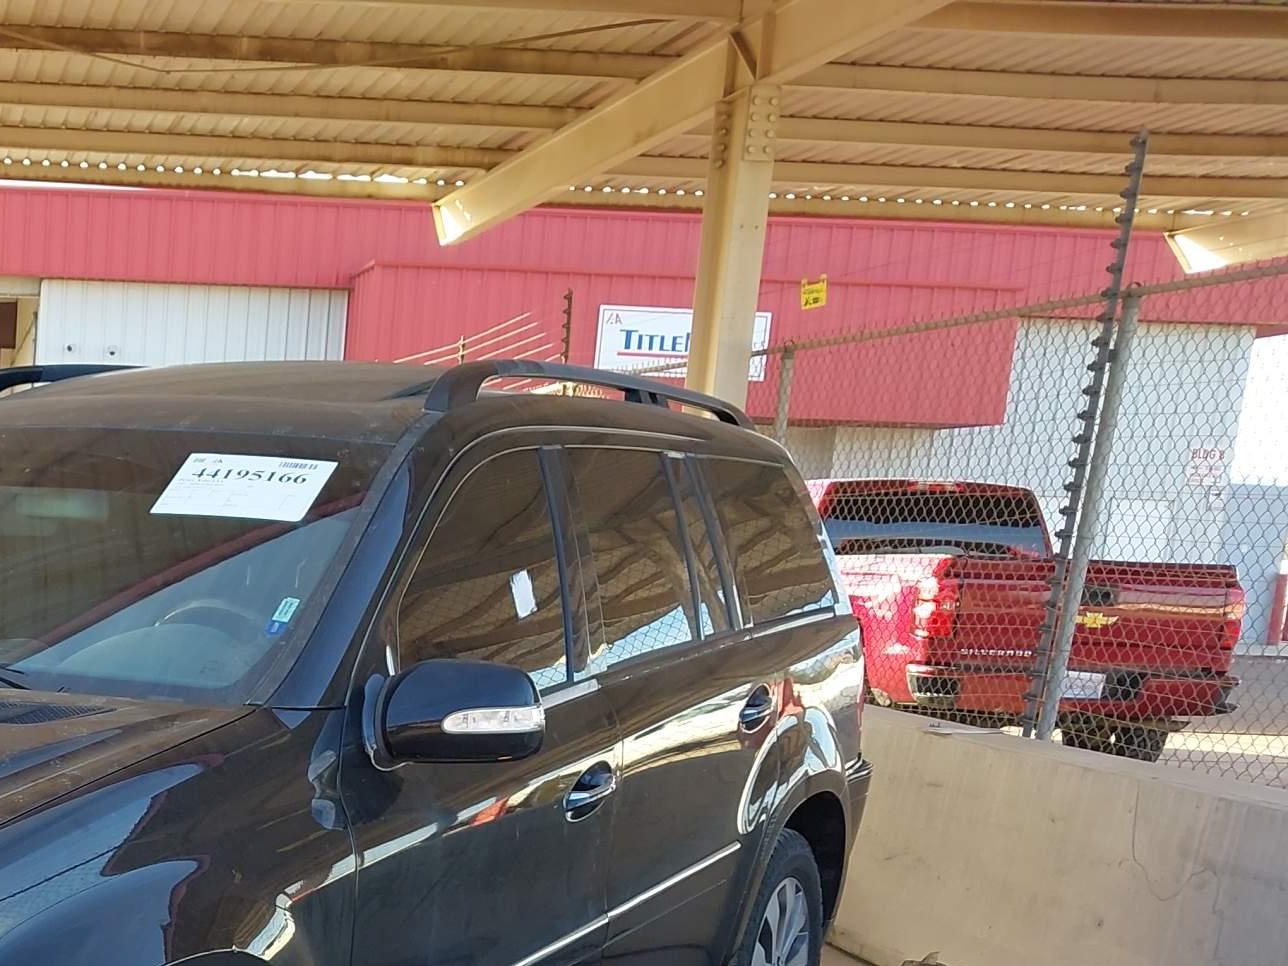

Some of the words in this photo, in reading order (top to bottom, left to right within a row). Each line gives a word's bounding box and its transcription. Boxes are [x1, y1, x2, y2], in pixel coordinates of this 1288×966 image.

[619, 328, 691, 353] TITLE
[1191, 448, 1216, 460] BLDG
[191, 467, 311, 486] 44195166
[959, 648, 1033, 658] SILVERADO
